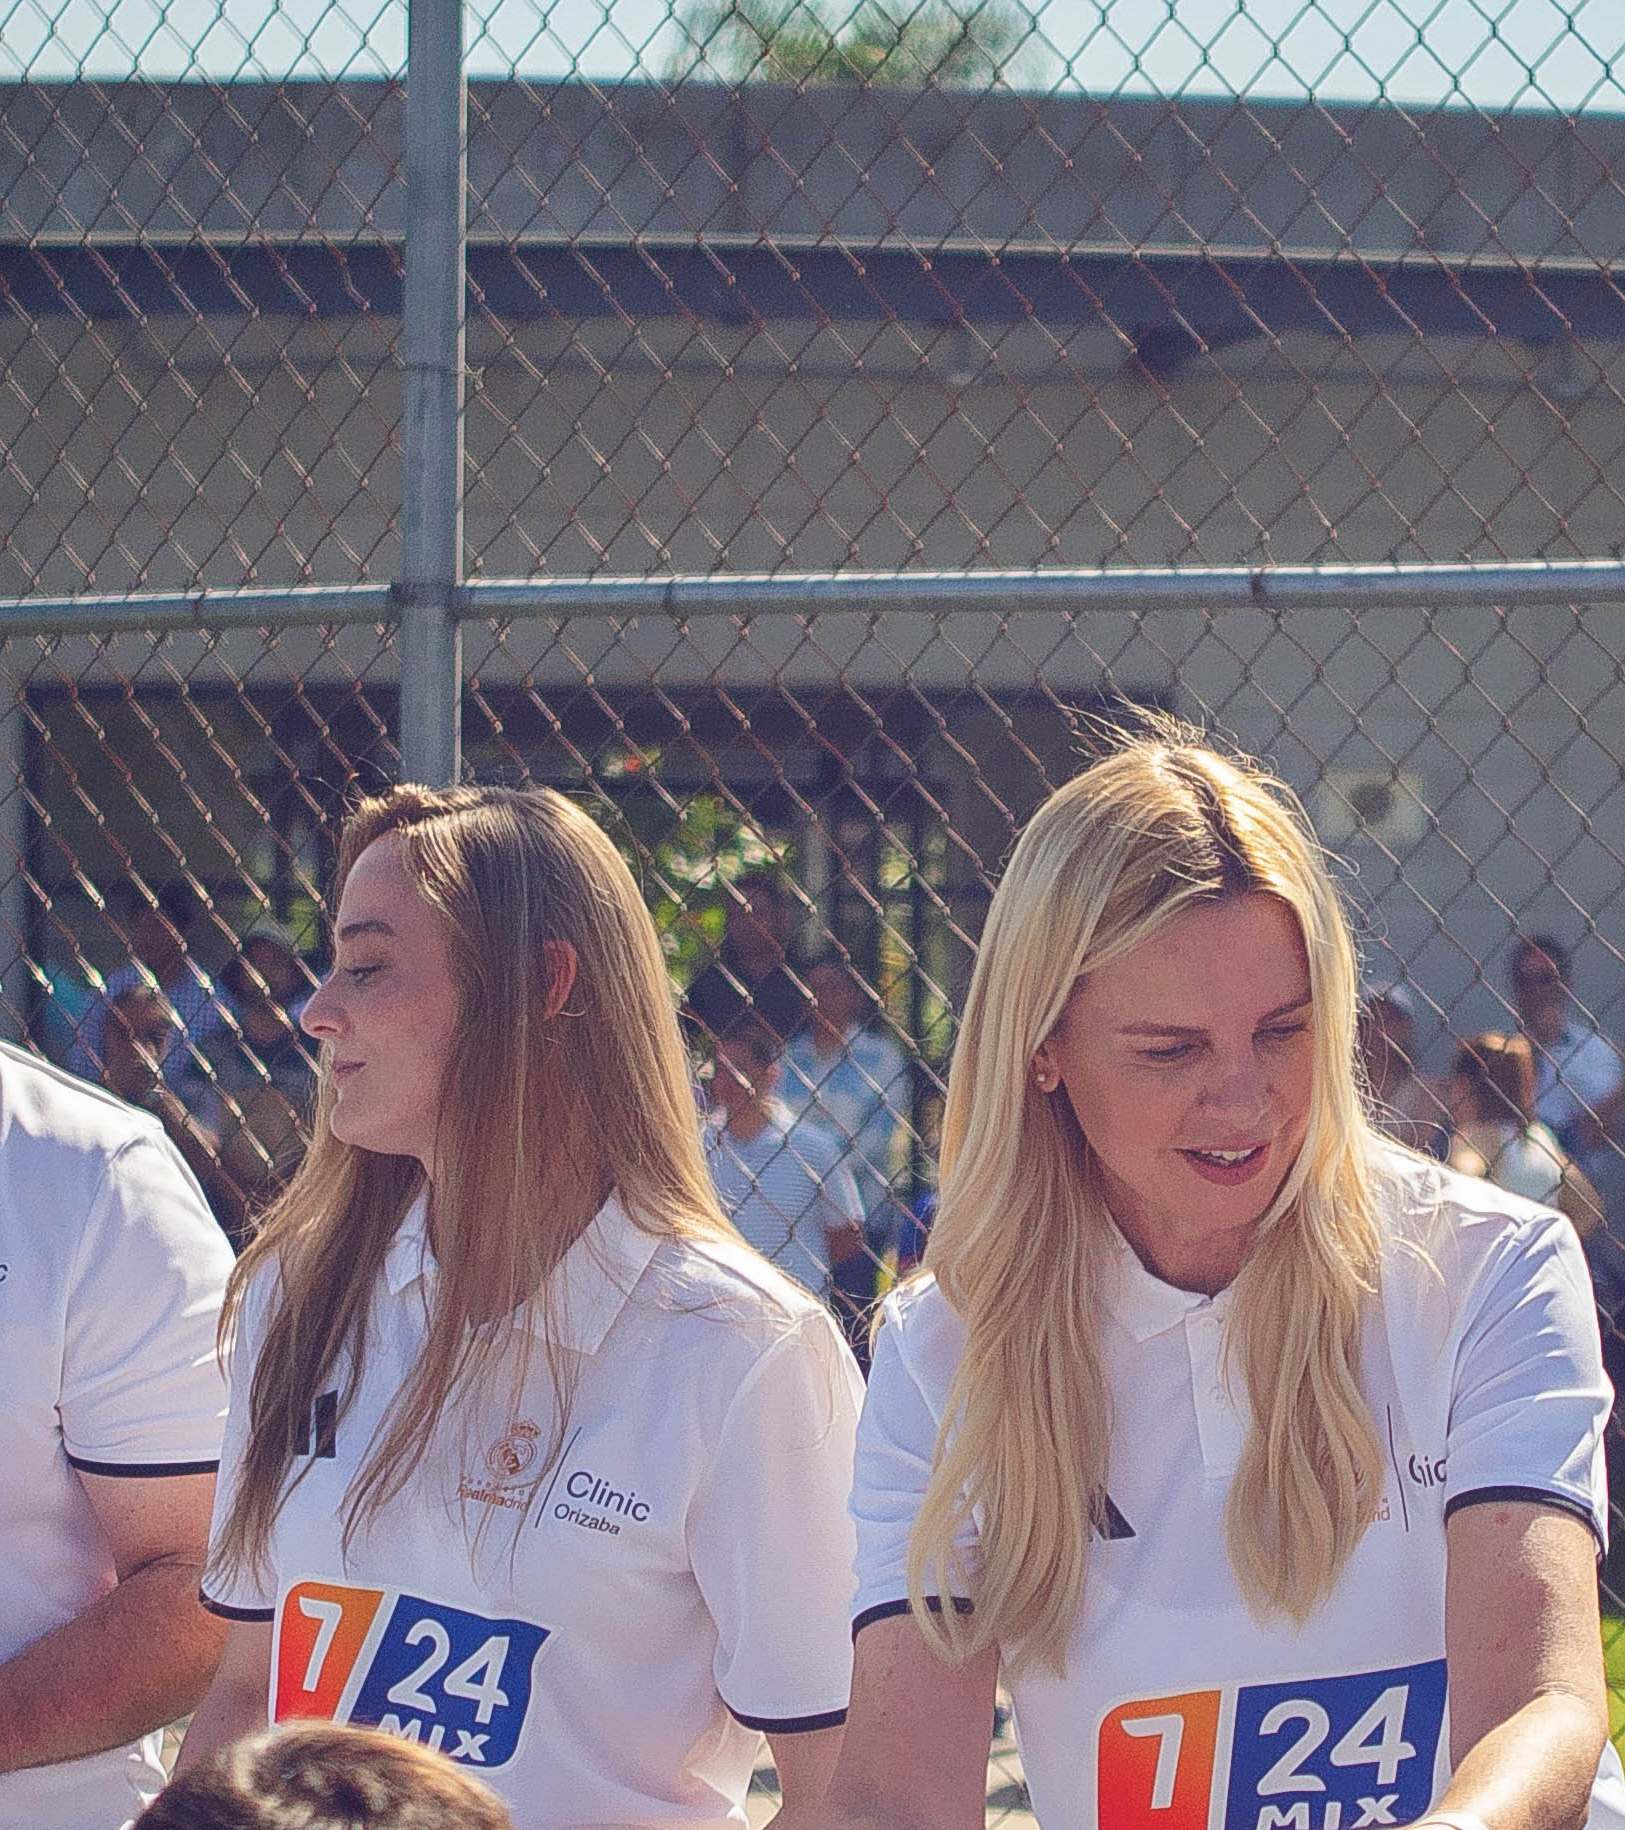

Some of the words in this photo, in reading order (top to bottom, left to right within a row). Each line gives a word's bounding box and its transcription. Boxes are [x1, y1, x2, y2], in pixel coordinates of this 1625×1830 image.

[553, 1503, 621, 1536] Orizaba
[566, 1471, 651, 1522] Clinic
[299, 1596, 343, 1693] 7
[386, 1618, 511, 1725] 24
[374, 1713, 492, 1762] MIX
[1121, 1712, 1185, 1810] 7
[1256, 1684, 1417, 1796] 24
